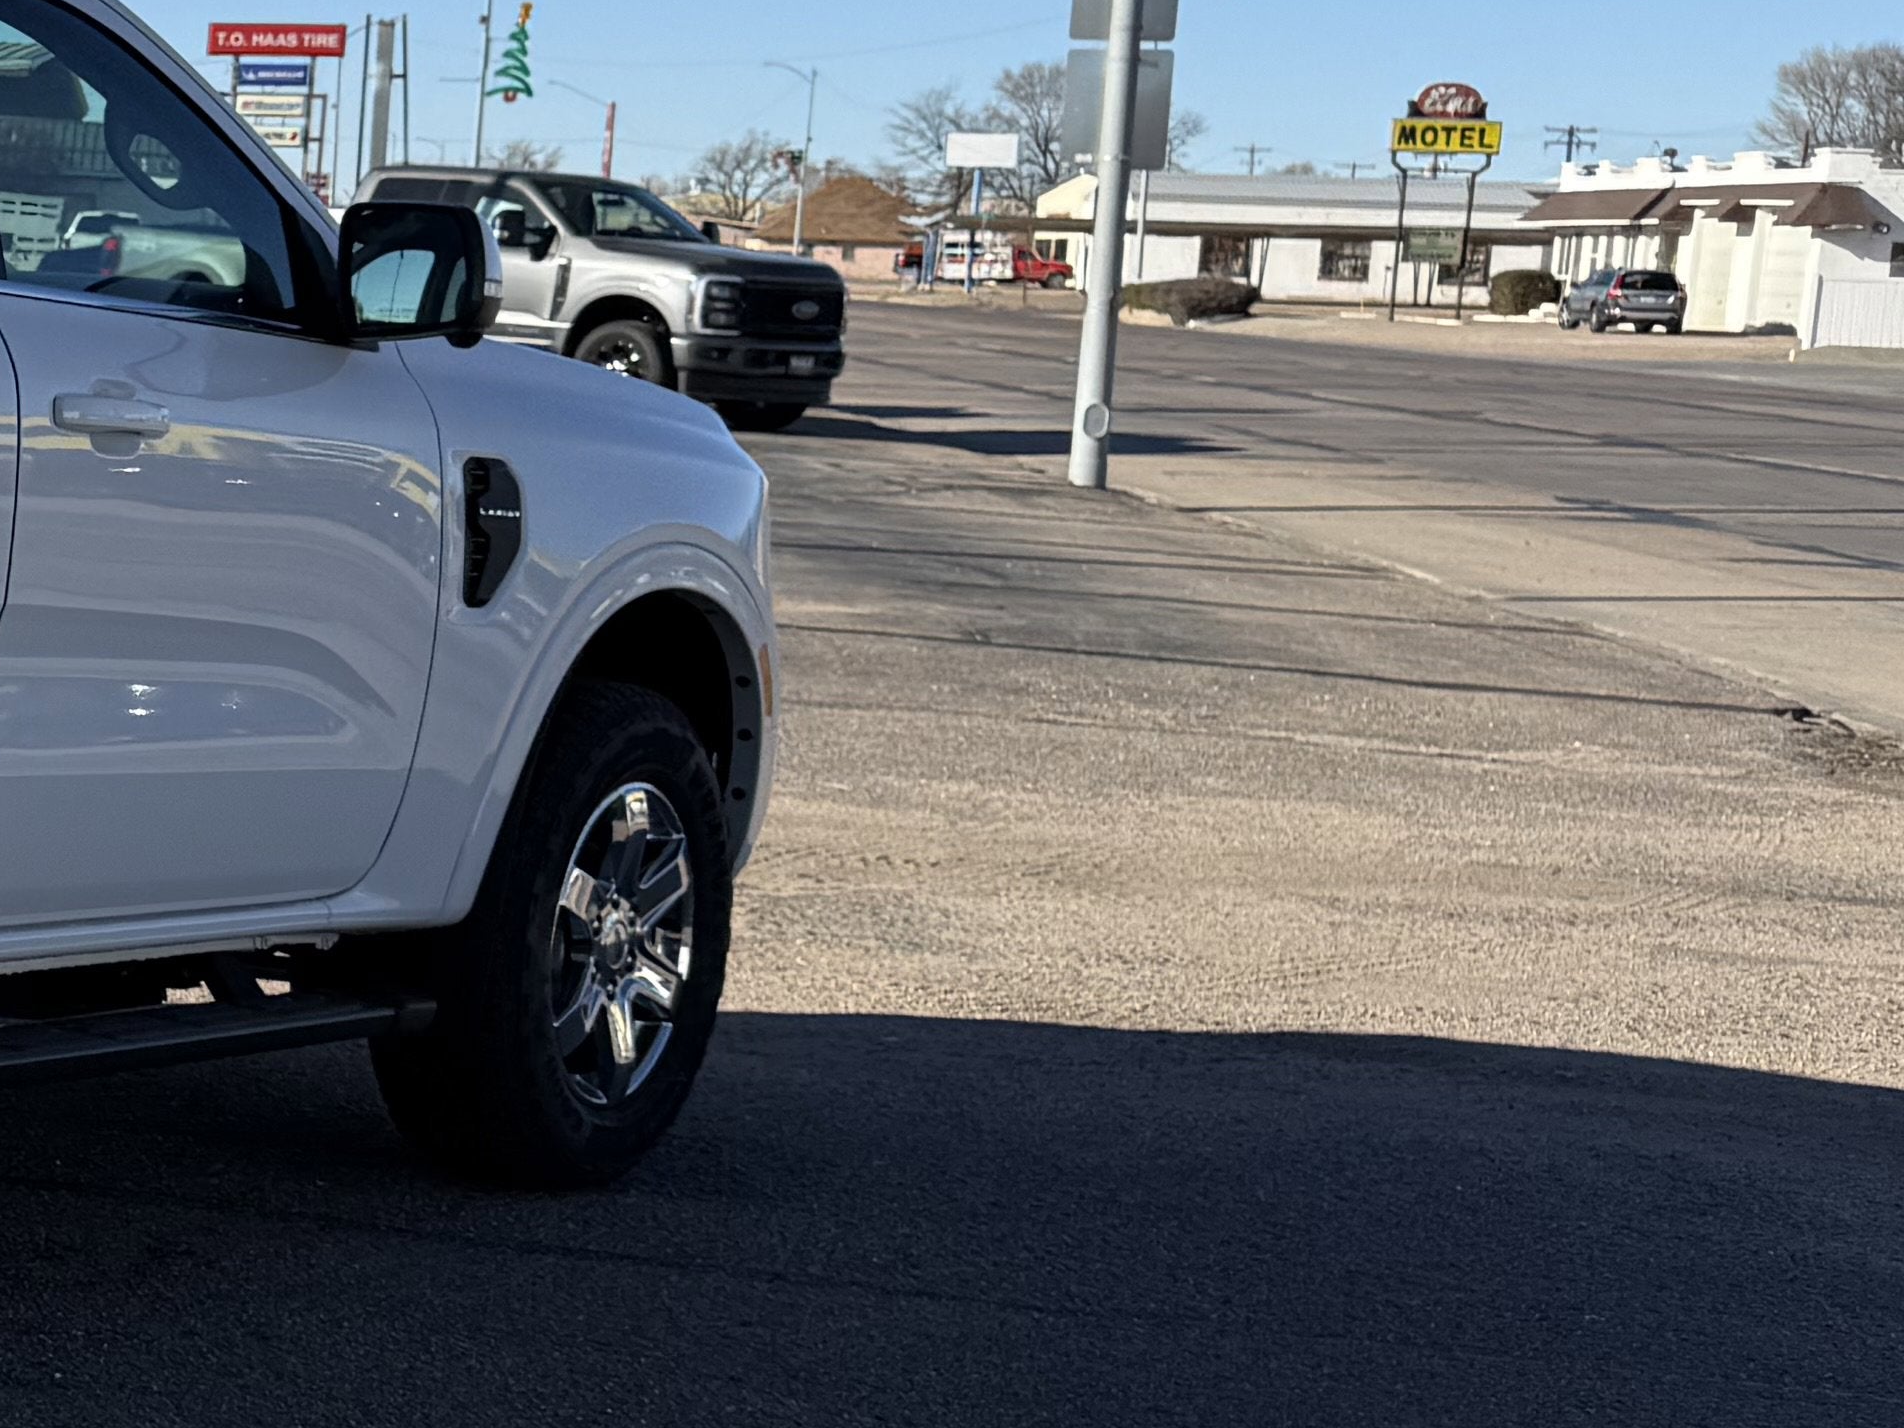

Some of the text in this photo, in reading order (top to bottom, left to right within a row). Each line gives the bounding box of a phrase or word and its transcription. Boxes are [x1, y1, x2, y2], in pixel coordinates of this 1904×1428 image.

[216, 30, 339, 48] T.O. HAAS TIRE
[1397, 124, 1494, 149] MOTEL
